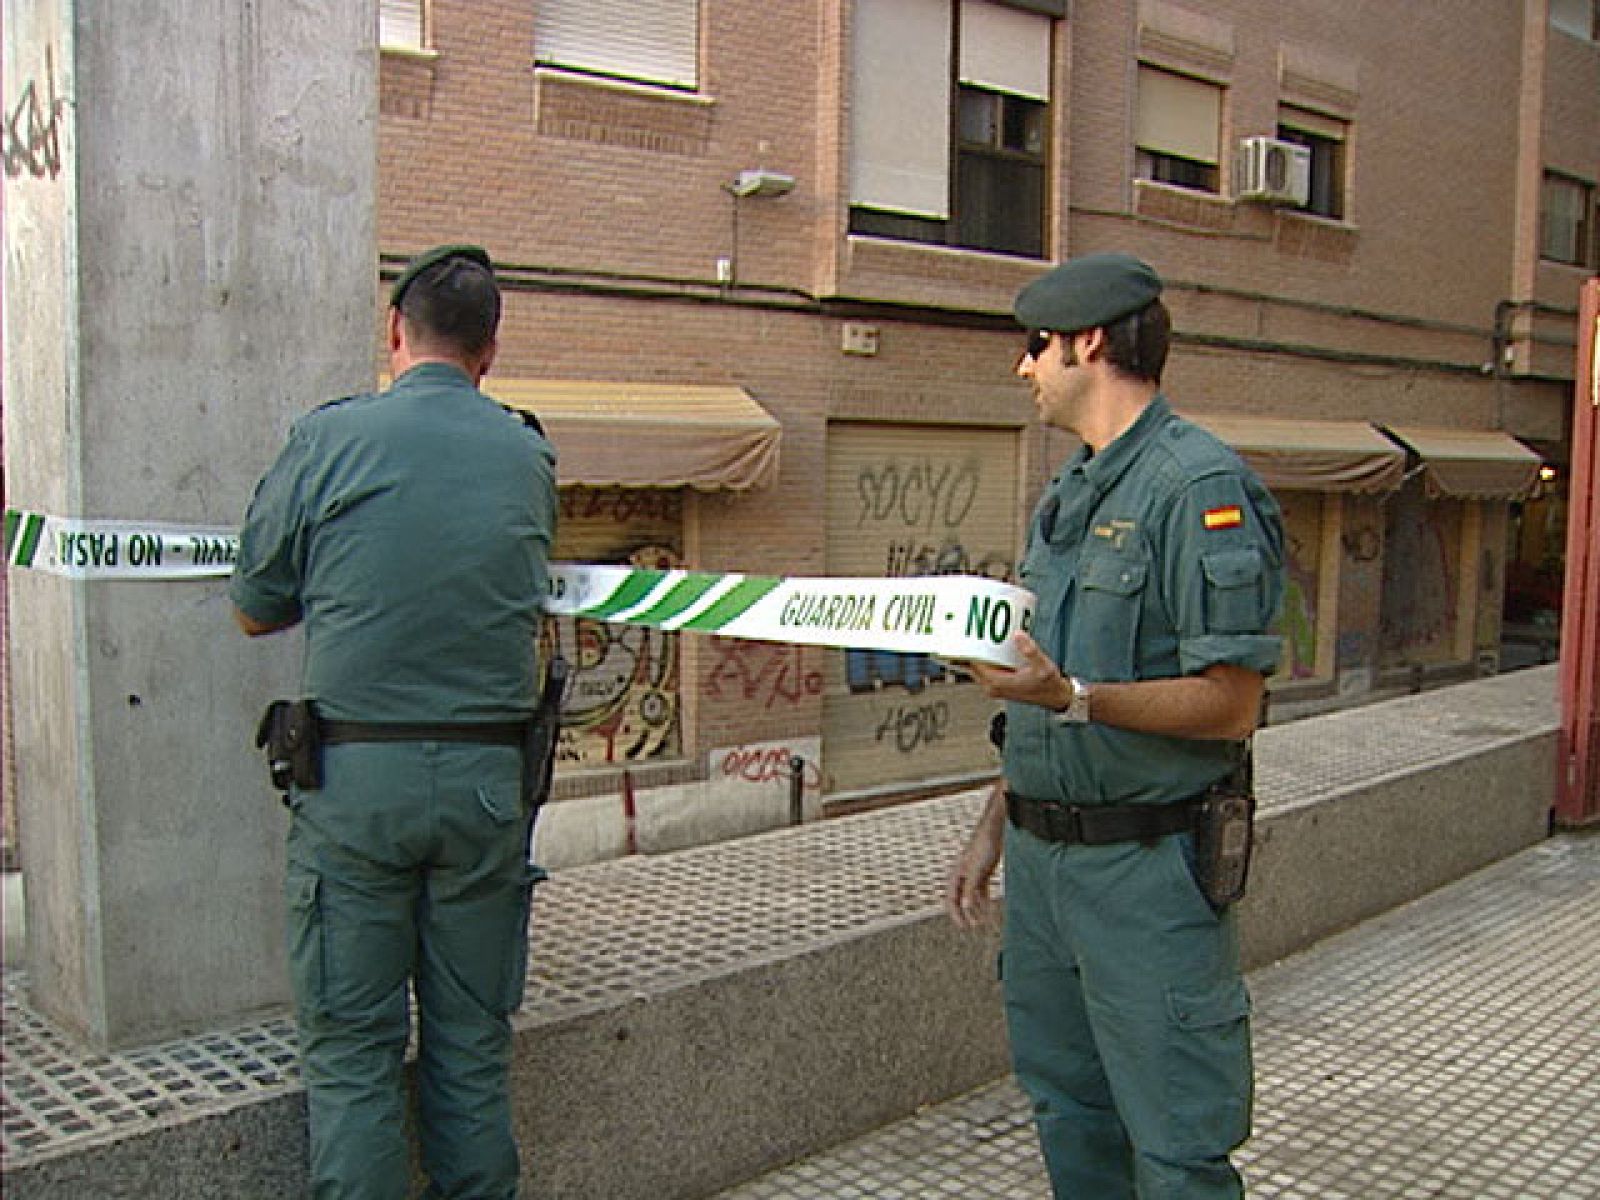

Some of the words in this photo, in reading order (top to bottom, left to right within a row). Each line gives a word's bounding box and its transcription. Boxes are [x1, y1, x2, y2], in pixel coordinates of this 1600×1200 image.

[129, 533, 162, 566] NO
[779, 592, 876, 631] GUARDIA
[883, 594, 936, 636] CIVIL
[964, 594, 1012, 644] NO
